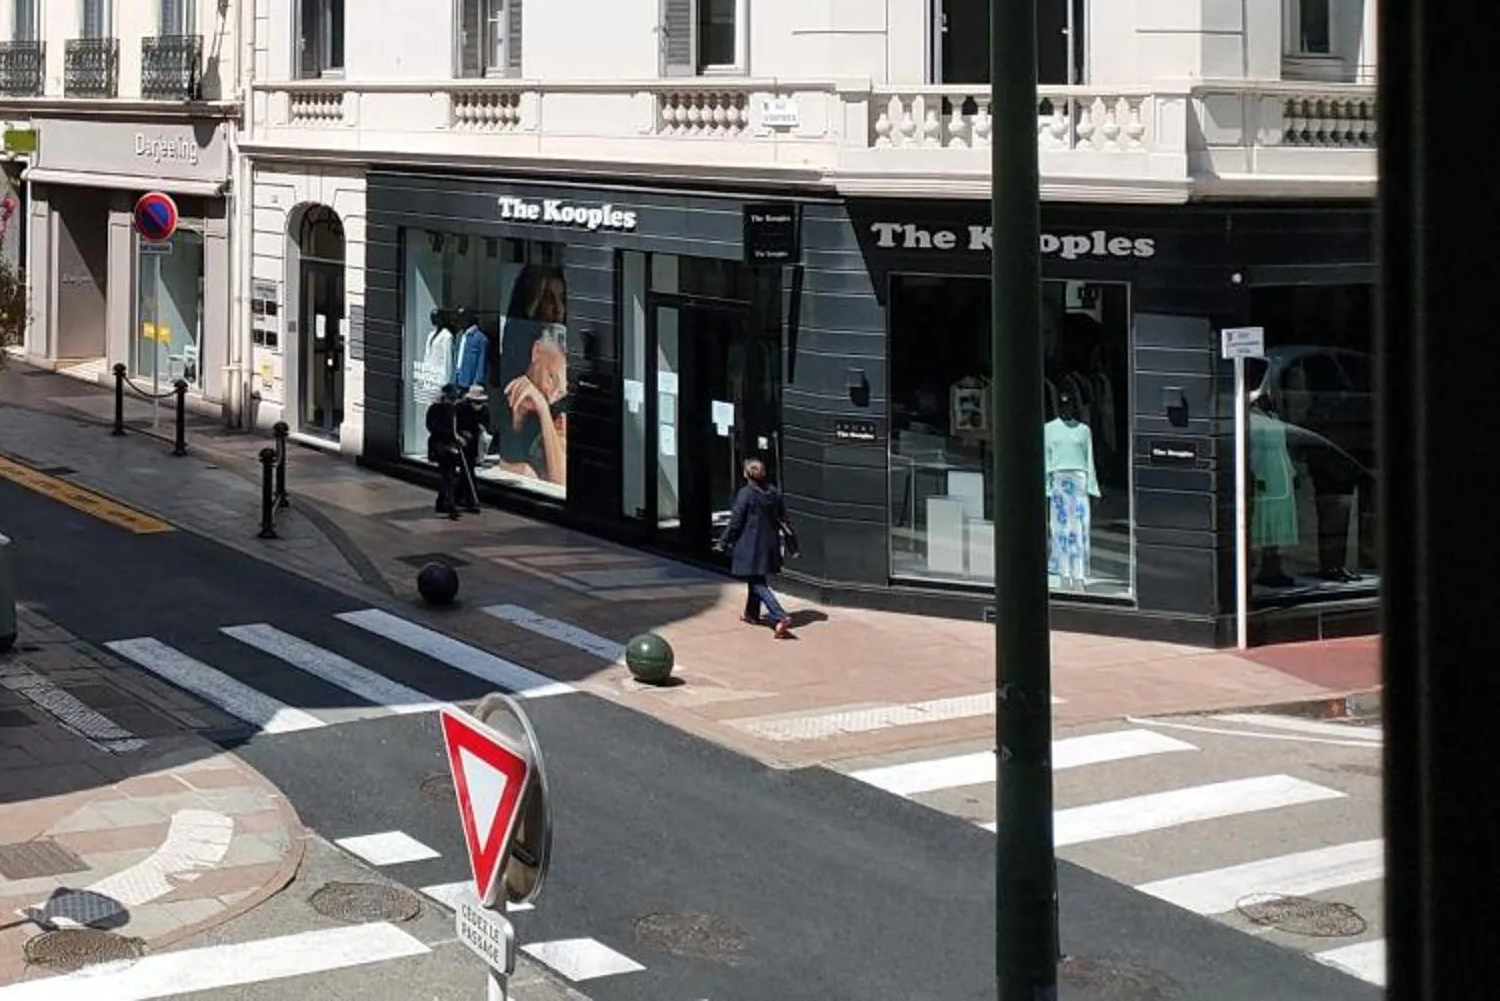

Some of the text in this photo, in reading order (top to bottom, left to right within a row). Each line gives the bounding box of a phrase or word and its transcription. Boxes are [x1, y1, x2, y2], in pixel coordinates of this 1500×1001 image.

[498, 197, 637, 230] The Kooples
[870, 222, 1156, 260] The Koples
